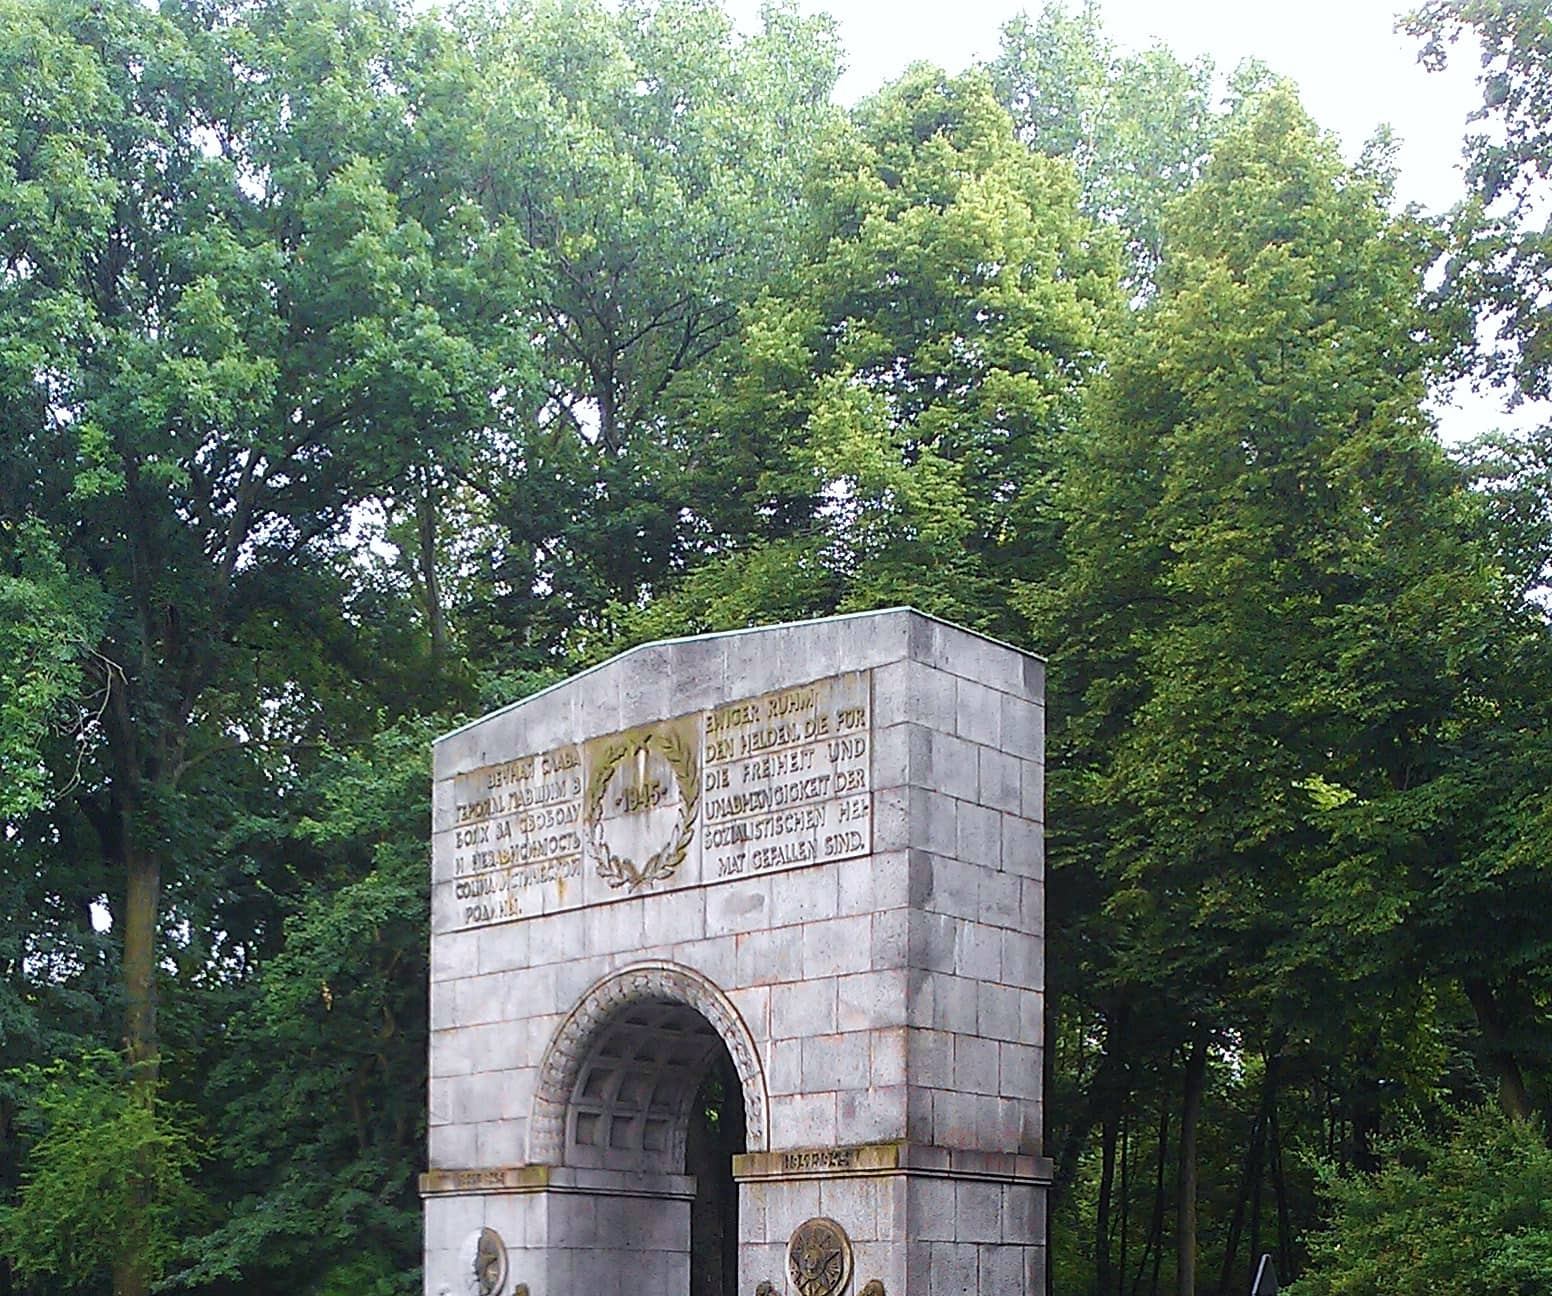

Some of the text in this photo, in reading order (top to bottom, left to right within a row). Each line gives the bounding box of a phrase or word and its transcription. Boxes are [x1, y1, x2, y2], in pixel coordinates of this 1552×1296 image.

[705, 689, 814, 734] EWIGER RUHM
[705, 741, 735, 764] DEN
[804, 716, 829, 740] DIE
[705, 738, 866, 791] DIE FREIHEIT UND
[835, 769, 866, 794] DER
[705, 806, 826, 850] SOZIALISTISCHEN
[718, 853, 746, 877] MAT
[752, 839, 818, 870] GEFALLEN
